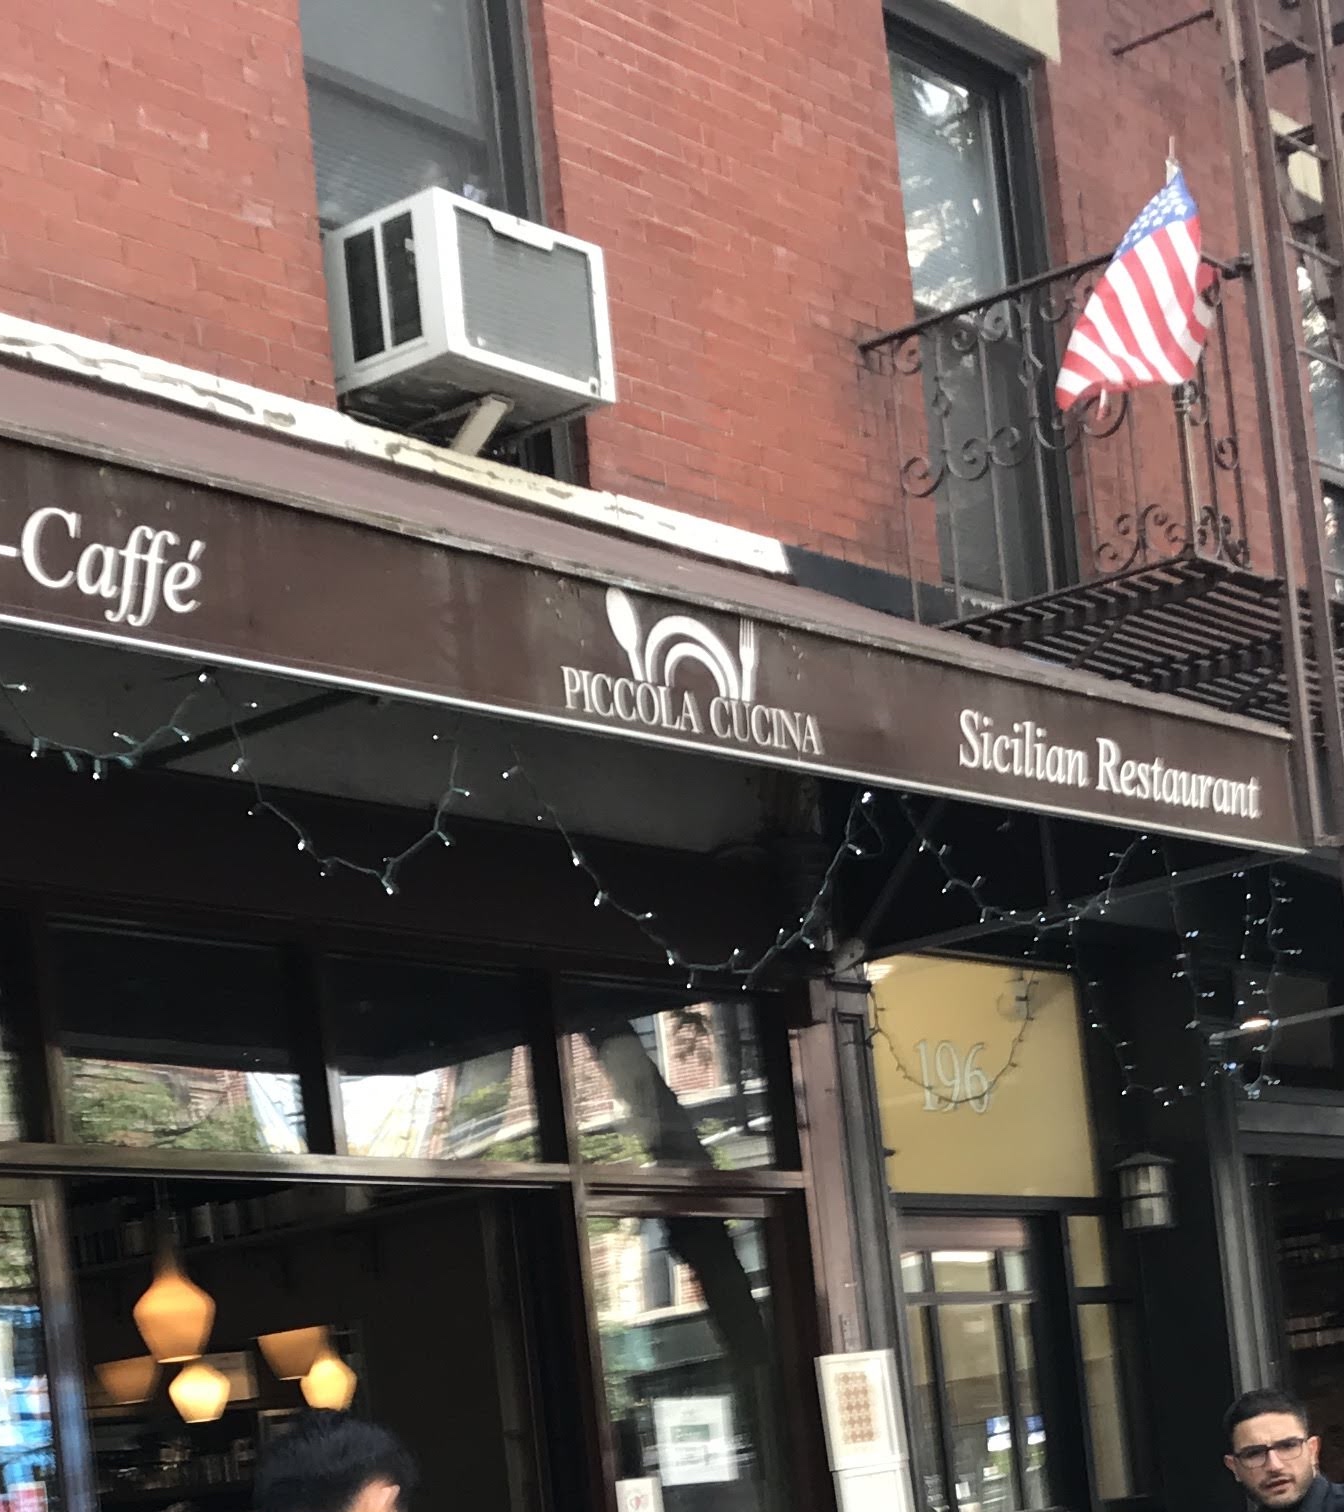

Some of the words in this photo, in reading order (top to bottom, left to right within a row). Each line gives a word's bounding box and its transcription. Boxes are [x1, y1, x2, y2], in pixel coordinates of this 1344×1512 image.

[561, 666, 703, 734] PICCOLA
[709, 696, 825, 755] CUCINA
[959, 709, 1089, 788] Sicilian
[1096, 737, 1261, 818] Restaurant
[916, 1039, 993, 1115] 196
